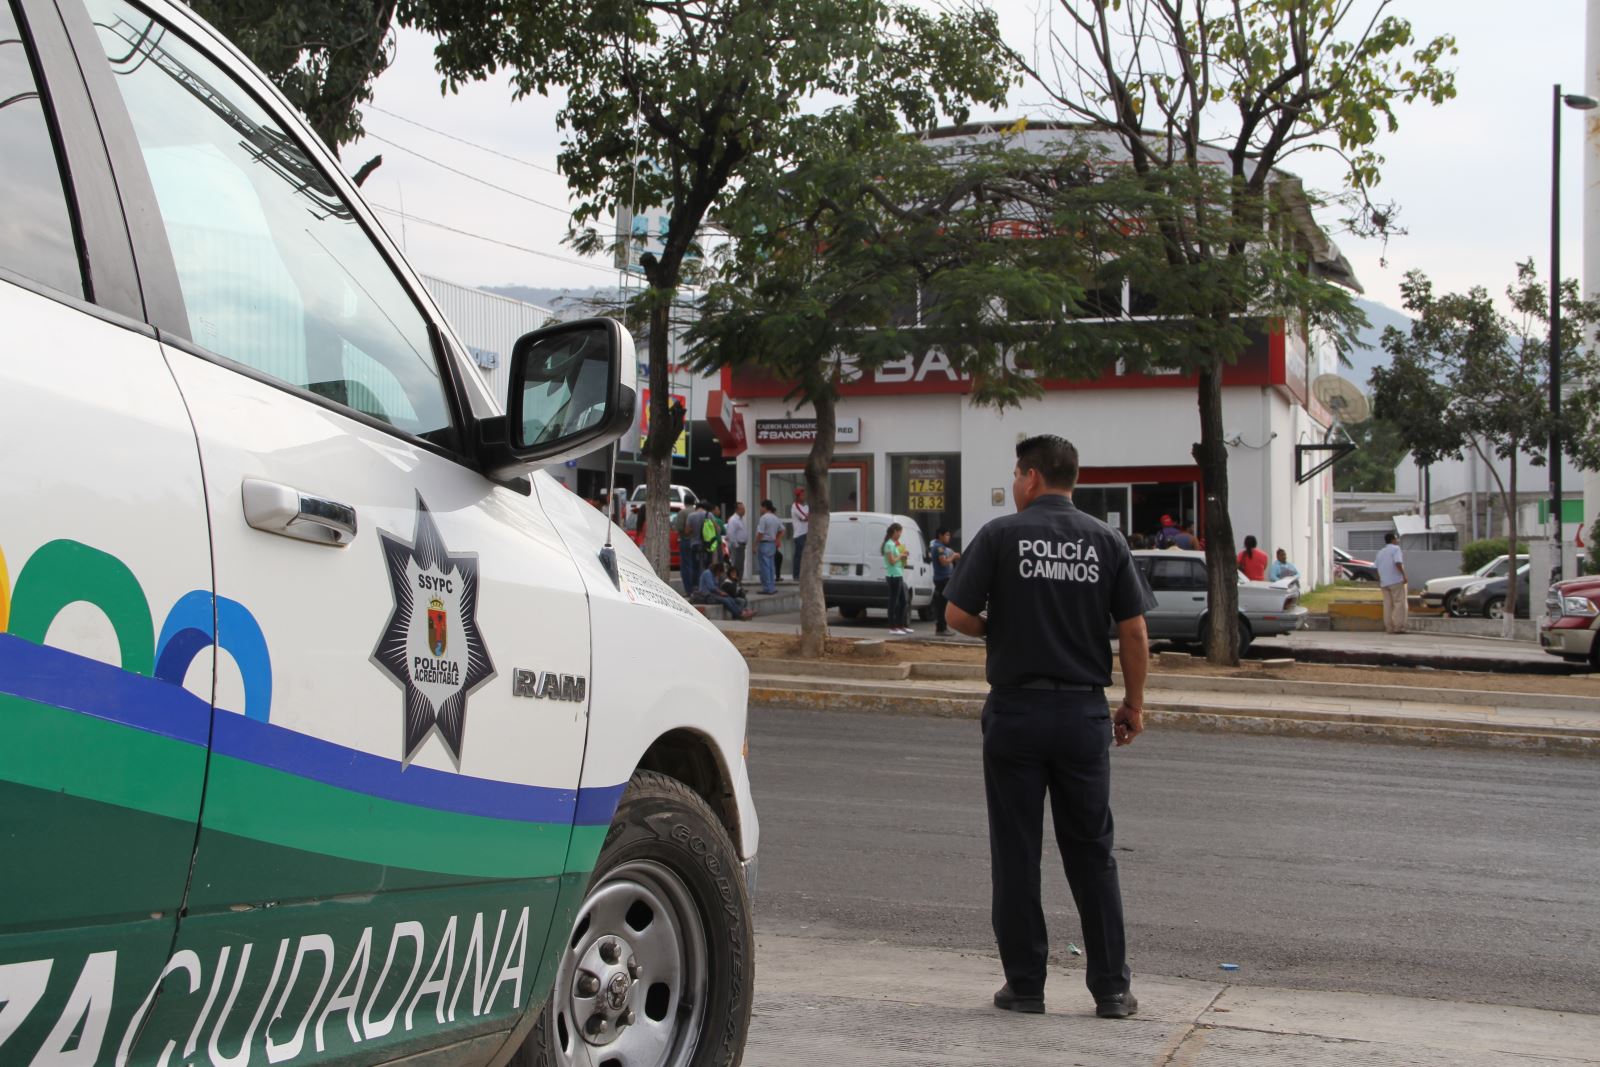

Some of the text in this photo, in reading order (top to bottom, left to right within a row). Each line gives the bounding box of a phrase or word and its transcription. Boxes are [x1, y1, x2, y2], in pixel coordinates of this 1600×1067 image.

[769, 430, 818, 440] BANORT
[911, 480, 943, 492] 17.52
[911, 497, 943, 508] 18.32
[1018, 538, 1100, 562] POLICÍA
[1019, 558, 1100, 583] CAMINOS
[418, 573, 453, 594] SSYPC
[414, 656, 459, 673] POLICIA
[414, 668, 459, 686] ACREDITABLE
[512, 667, 586, 703] RAM
[671, 822, 743, 1049] GOODYEAR
[114, 906, 530, 1067] CIUDADANA
